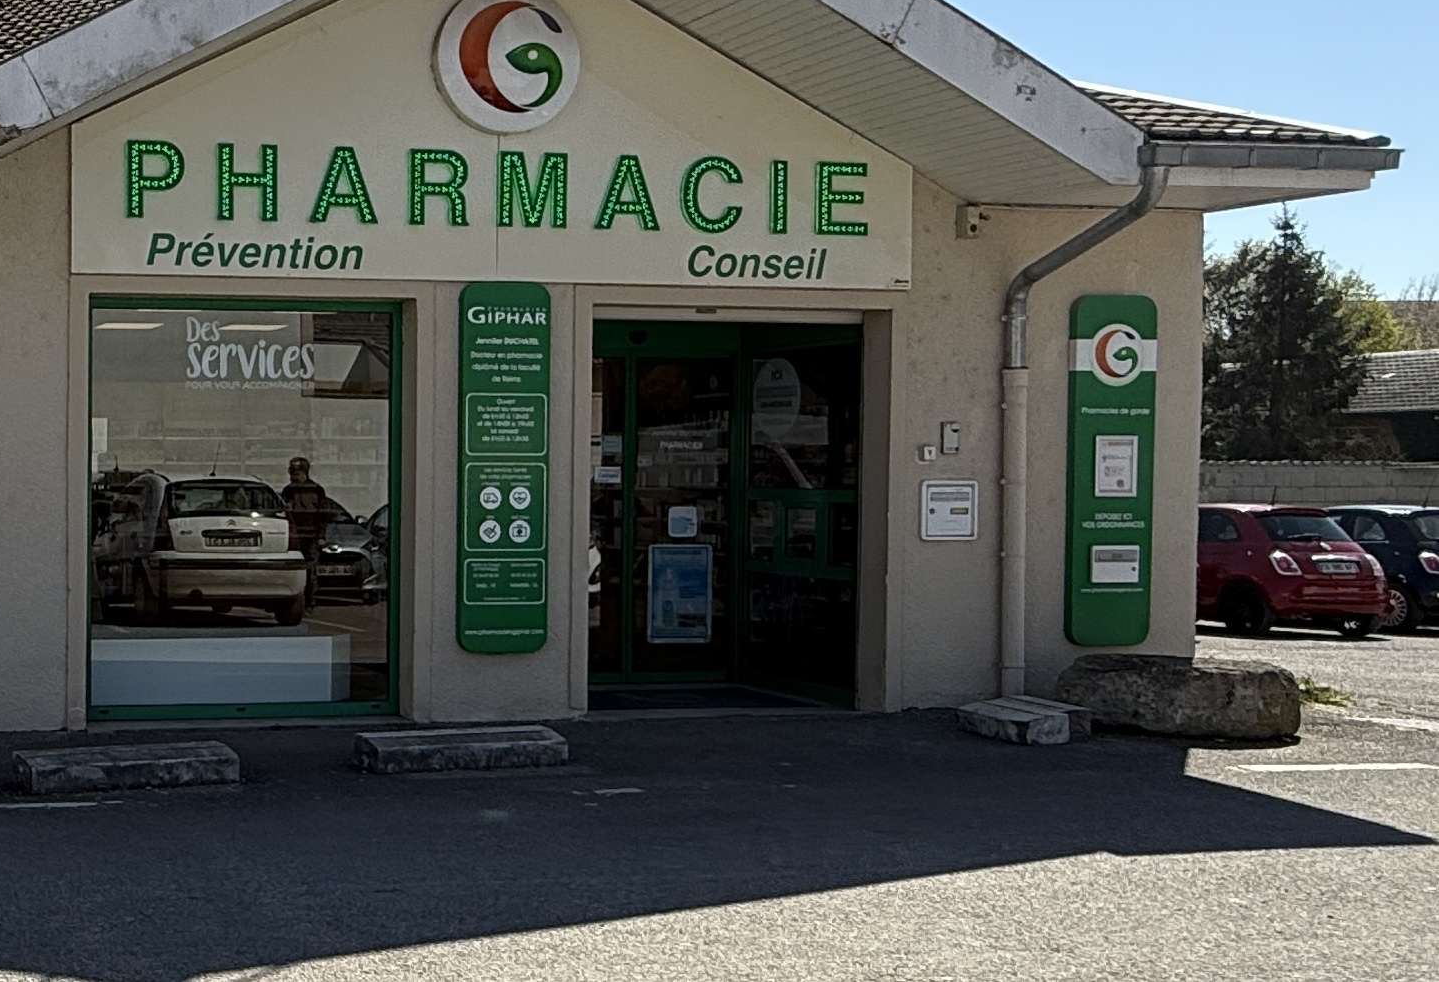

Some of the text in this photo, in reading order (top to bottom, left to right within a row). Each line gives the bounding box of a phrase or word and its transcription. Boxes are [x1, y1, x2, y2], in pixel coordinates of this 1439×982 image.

[124, 139, 870, 237] PHARMACIE
[147, 233, 364, 270] Prévention
[688, 245, 826, 281] Conseil
[186, 316, 220, 342] Des
[467, 306, 547, 325] GIPHAR
[186, 339, 314, 379] services
[186, 381, 314, 389] POUR VOUS ACCOMPAGNER
